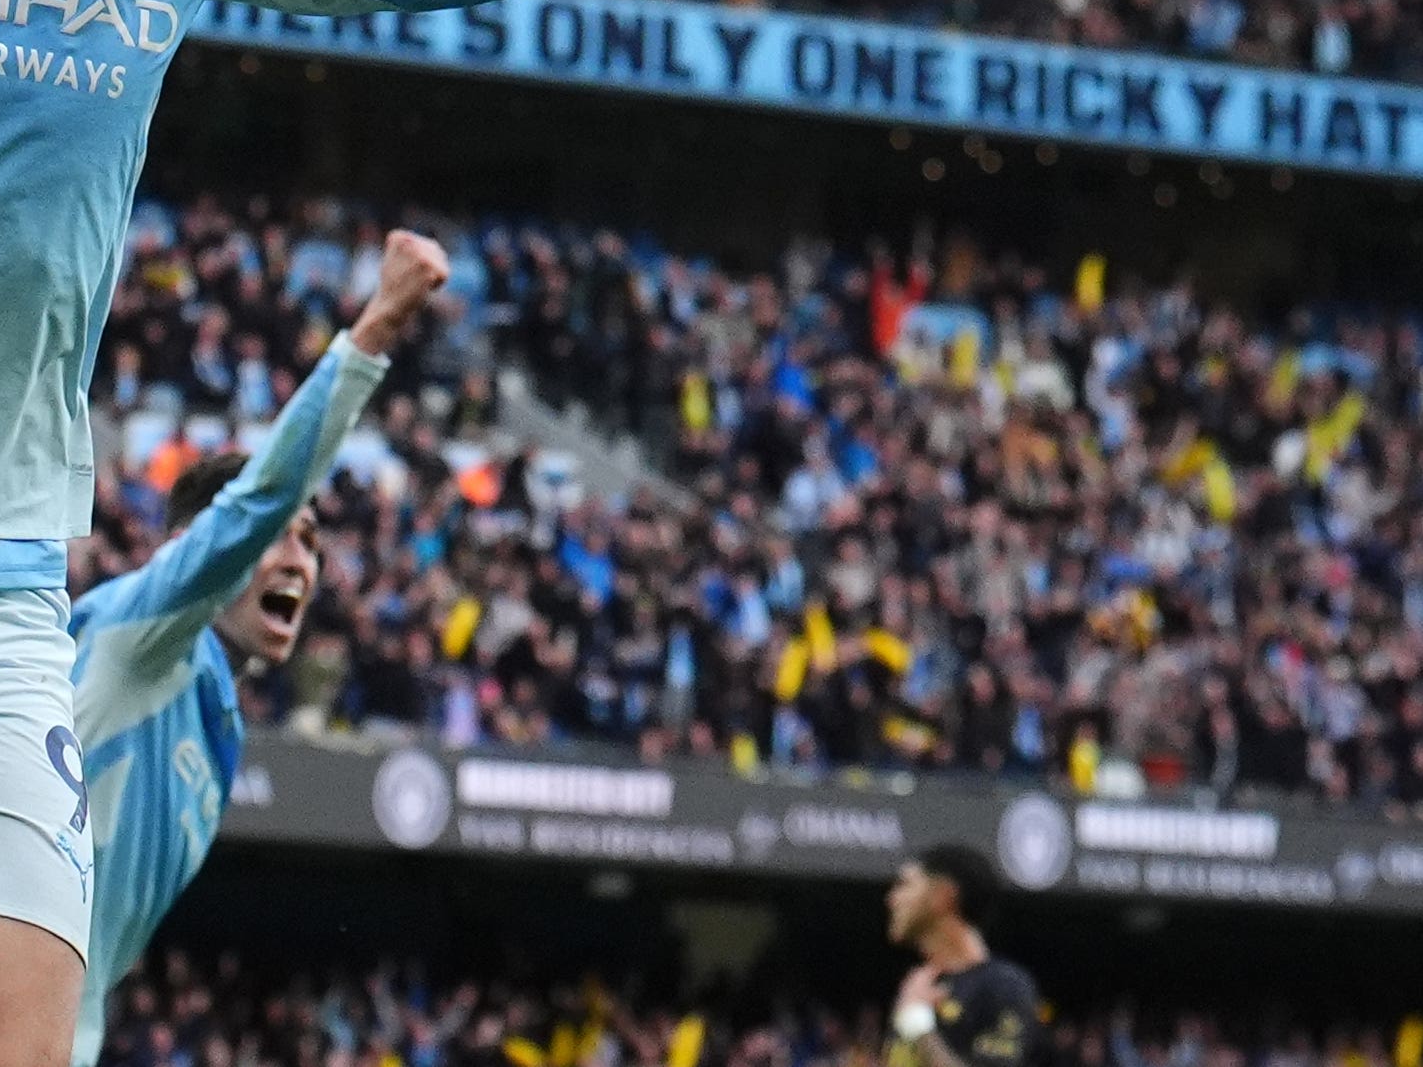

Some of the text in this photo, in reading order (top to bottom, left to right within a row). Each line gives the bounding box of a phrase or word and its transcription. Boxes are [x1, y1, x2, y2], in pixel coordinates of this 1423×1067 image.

[539, 0, 759, 85] ONLY
[789, 32, 948, 109] ONE
[973, 51, 1228, 134] RICKY
[45, 724, 88, 835] 9
